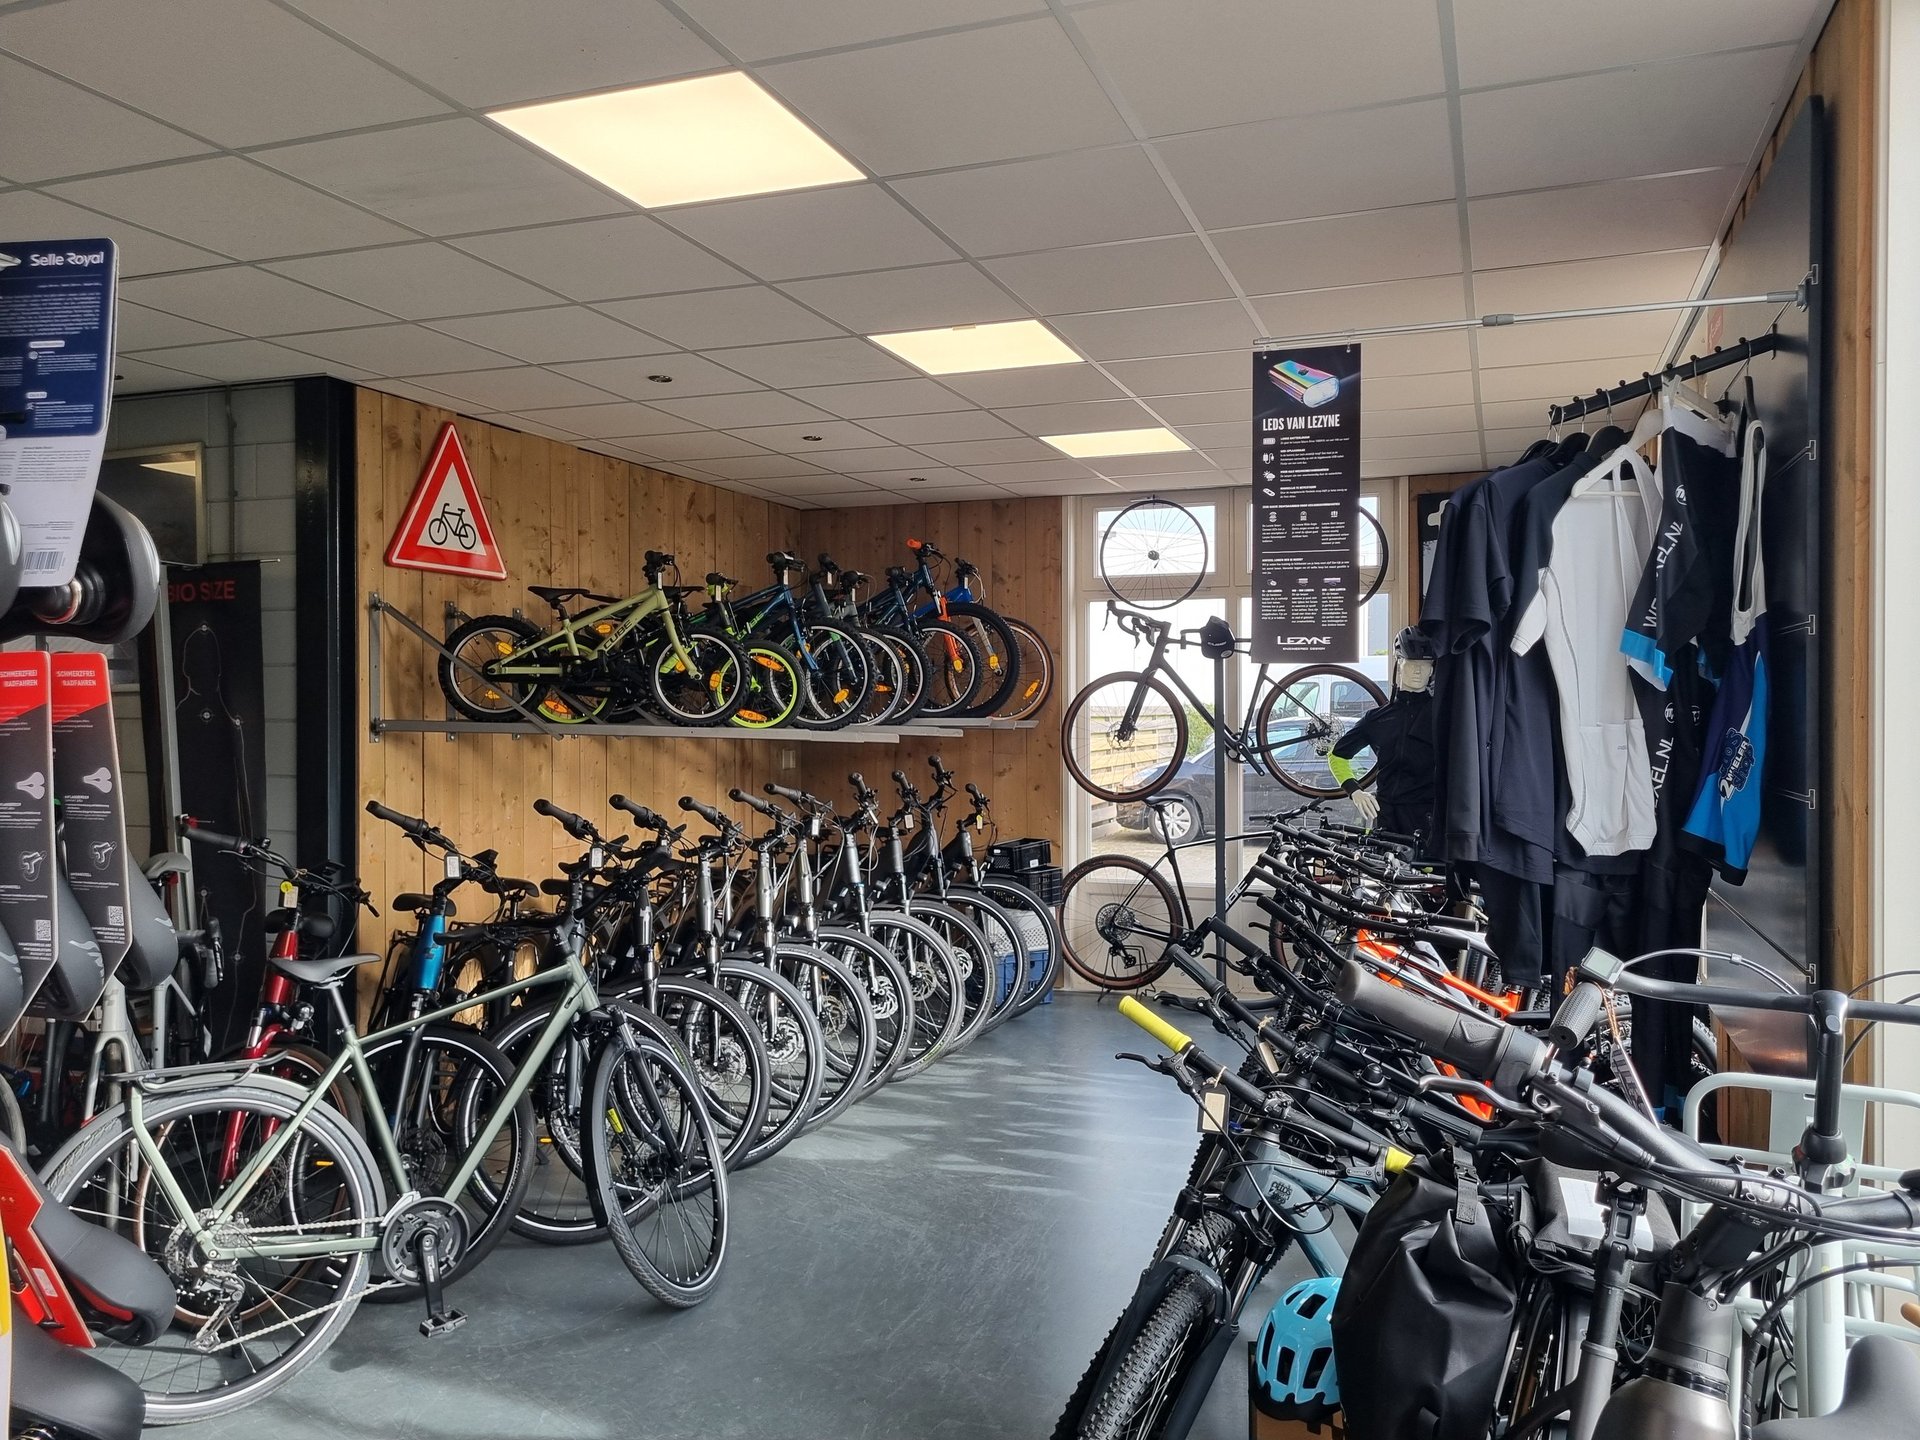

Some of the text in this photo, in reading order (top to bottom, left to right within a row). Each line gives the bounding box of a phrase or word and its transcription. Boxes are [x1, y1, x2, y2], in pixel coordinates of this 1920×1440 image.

[30, 251, 105, 267] Selle Royal
[1262, 414, 1340, 431] LEDS VAN LEZYNE
[168, 580, 236, 603] BIO SIZE
[602, 619, 633, 650] CUBE
[1277, 635, 1332, 645] LEZYNE
